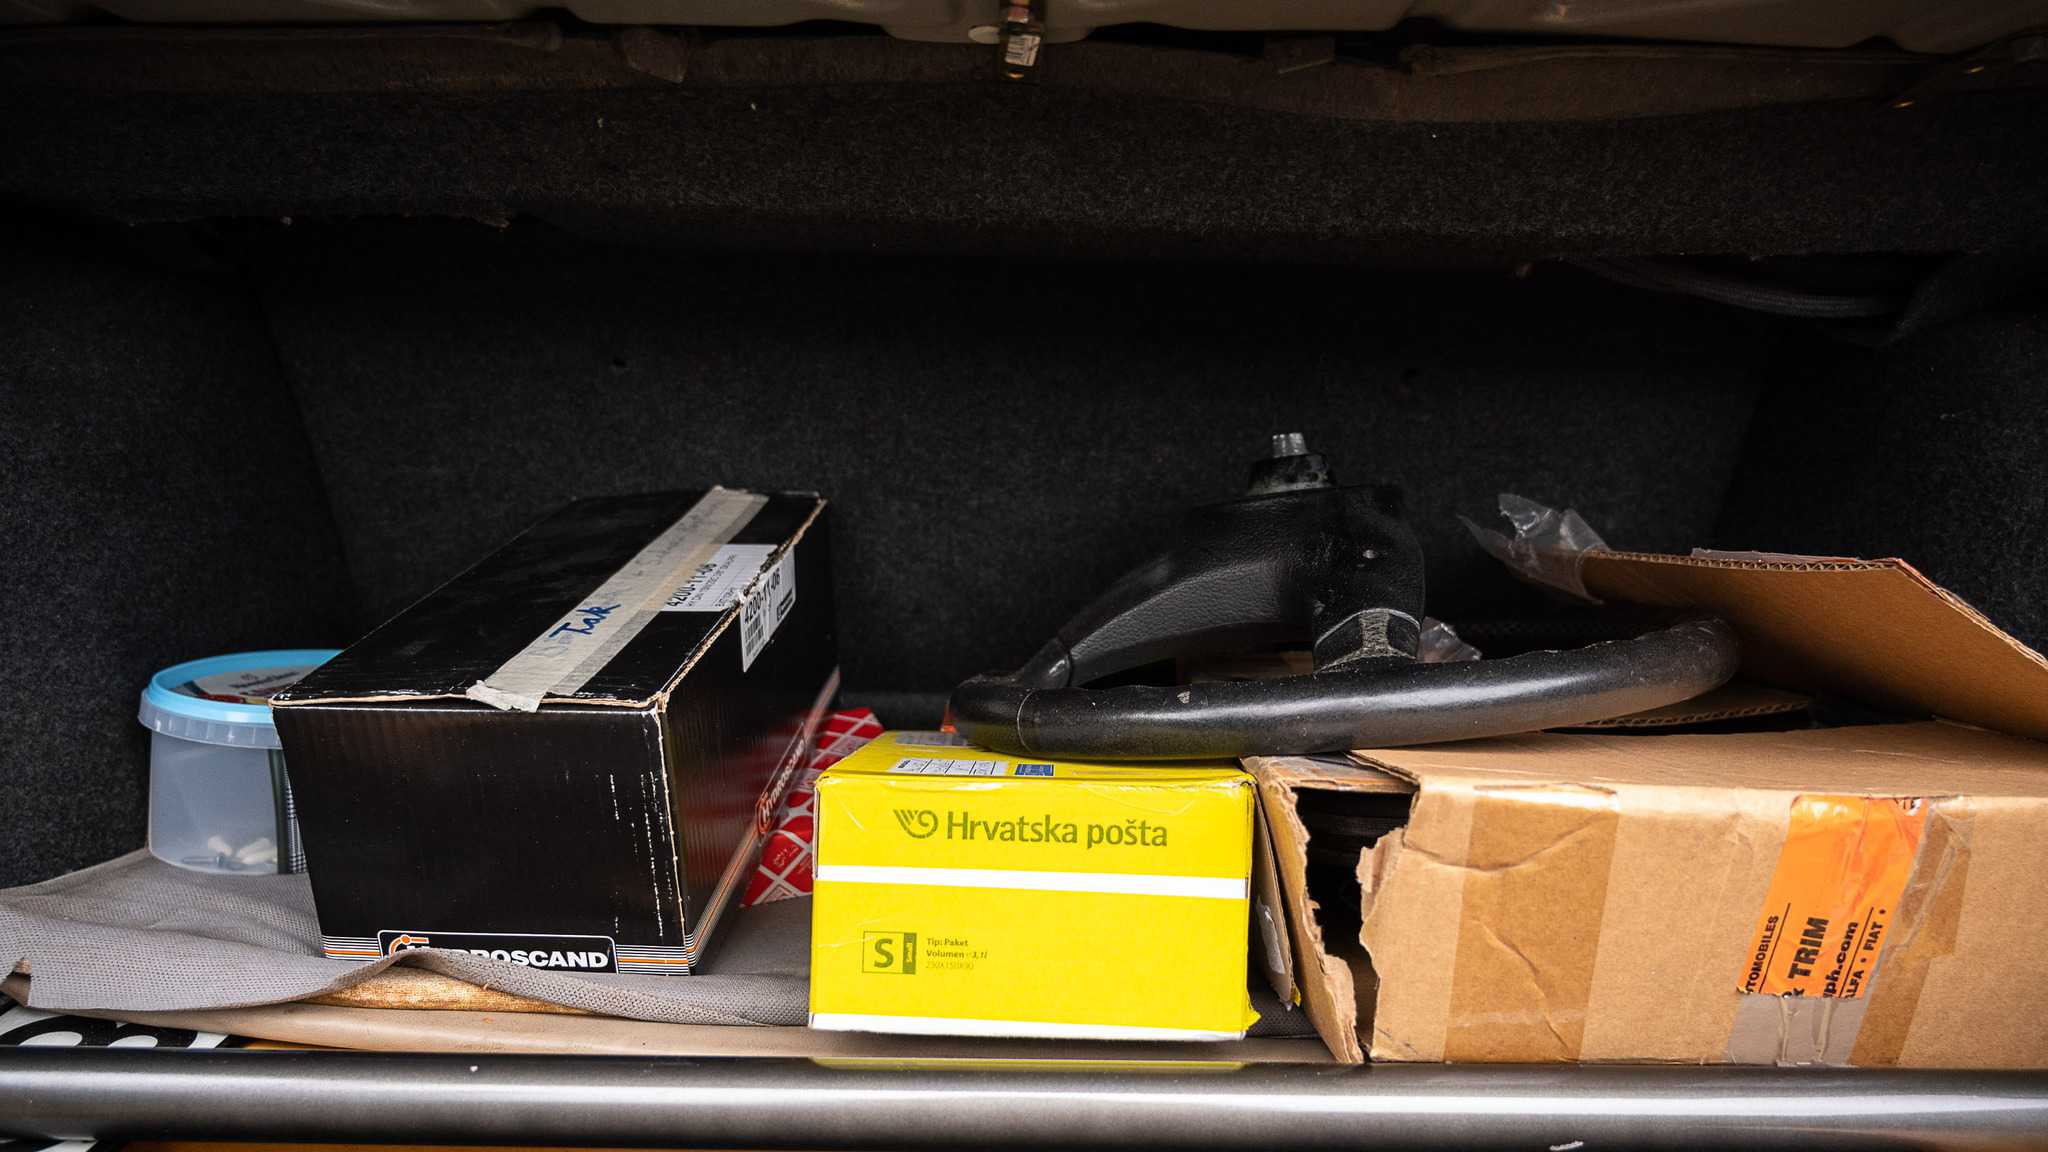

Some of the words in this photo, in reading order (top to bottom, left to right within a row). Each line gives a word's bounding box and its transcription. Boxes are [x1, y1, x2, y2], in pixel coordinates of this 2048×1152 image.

[744, 568, 781, 625] 4200-11-06
[762, 739, 806, 823] HYDROSCAND
[947, 811, 1078, 844] Hrvatska
[1088, 819, 1168, 850] pošta
[874, 938, 894, 968] S
[926, 938, 943, 947] Tip:
[944, 938, 968, 947] Paket
[1788, 917, 1829, 979] TRIM
[1863, 921, 1883, 951] FIAT
[926, 949, 964, 958] Volumen
[926, 960, 974, 970] 230X150X90
[1746, 915, 1779, 994] TOMOBILES
